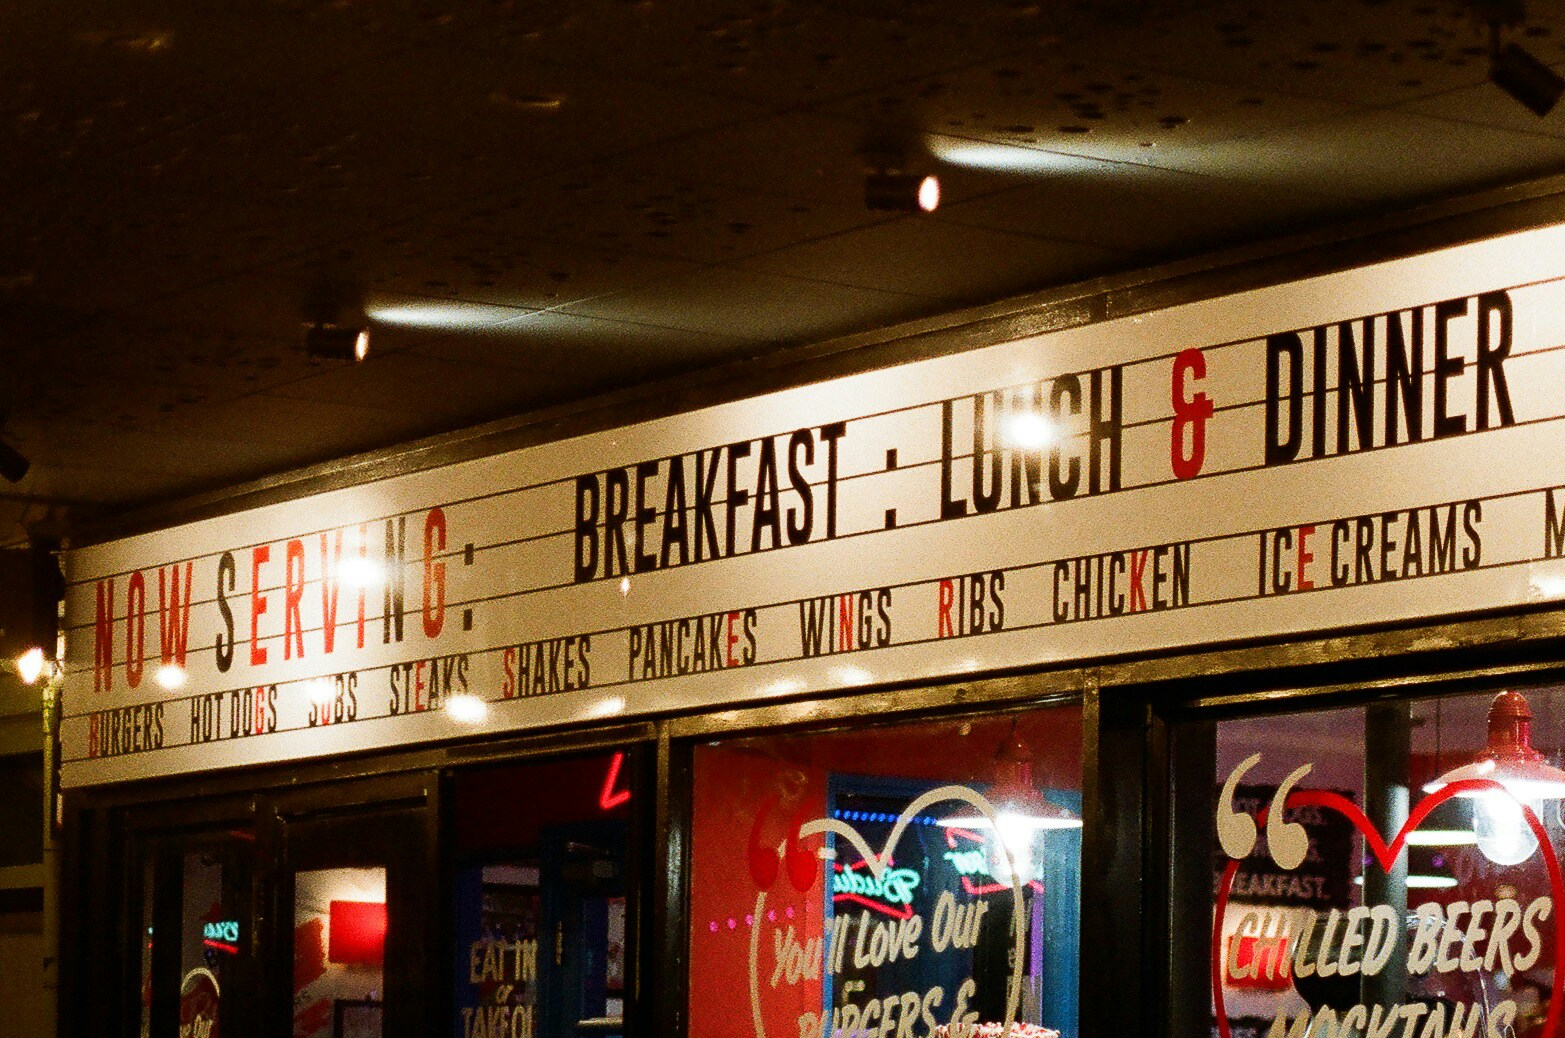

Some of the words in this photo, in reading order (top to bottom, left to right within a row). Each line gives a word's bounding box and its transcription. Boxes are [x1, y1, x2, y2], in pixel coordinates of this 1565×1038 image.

[94, 560, 194, 694] NOW
[574, 421, 846, 583] BREAKFAST
[941, 365, 1122, 520] LUNCH
[1170, 347, 1214, 481] &
[1265, 289, 1516, 467] DINNER
[88, 702, 165, 758] BURGERS
[191, 688, 222, 744] HOT
[231, 684, 279, 738] DOGS
[390, 654, 470, 716] STEAKS
[503, 636, 591, 699] SHAKES
[628, 608, 758, 683] PANCAKES
[800, 587, 893, 659] WINGS
[937, 570, 1006, 638] RIBS
[1052, 543, 1192, 626] CHICKEN
[1258, 524, 1318, 597] ICE
[1330, 500, 1482, 588] CREAMS
[469, 939, 508, 984] EAT
[514, 938, 538, 982] IN
[770, 912, 851, 989] You'll
[854, 909, 924, 969] Love
[931, 889, 989, 953] Our
[1228, 903, 1400, 982] CHILLED
[1406, 896, 1553, 979] BEERS
